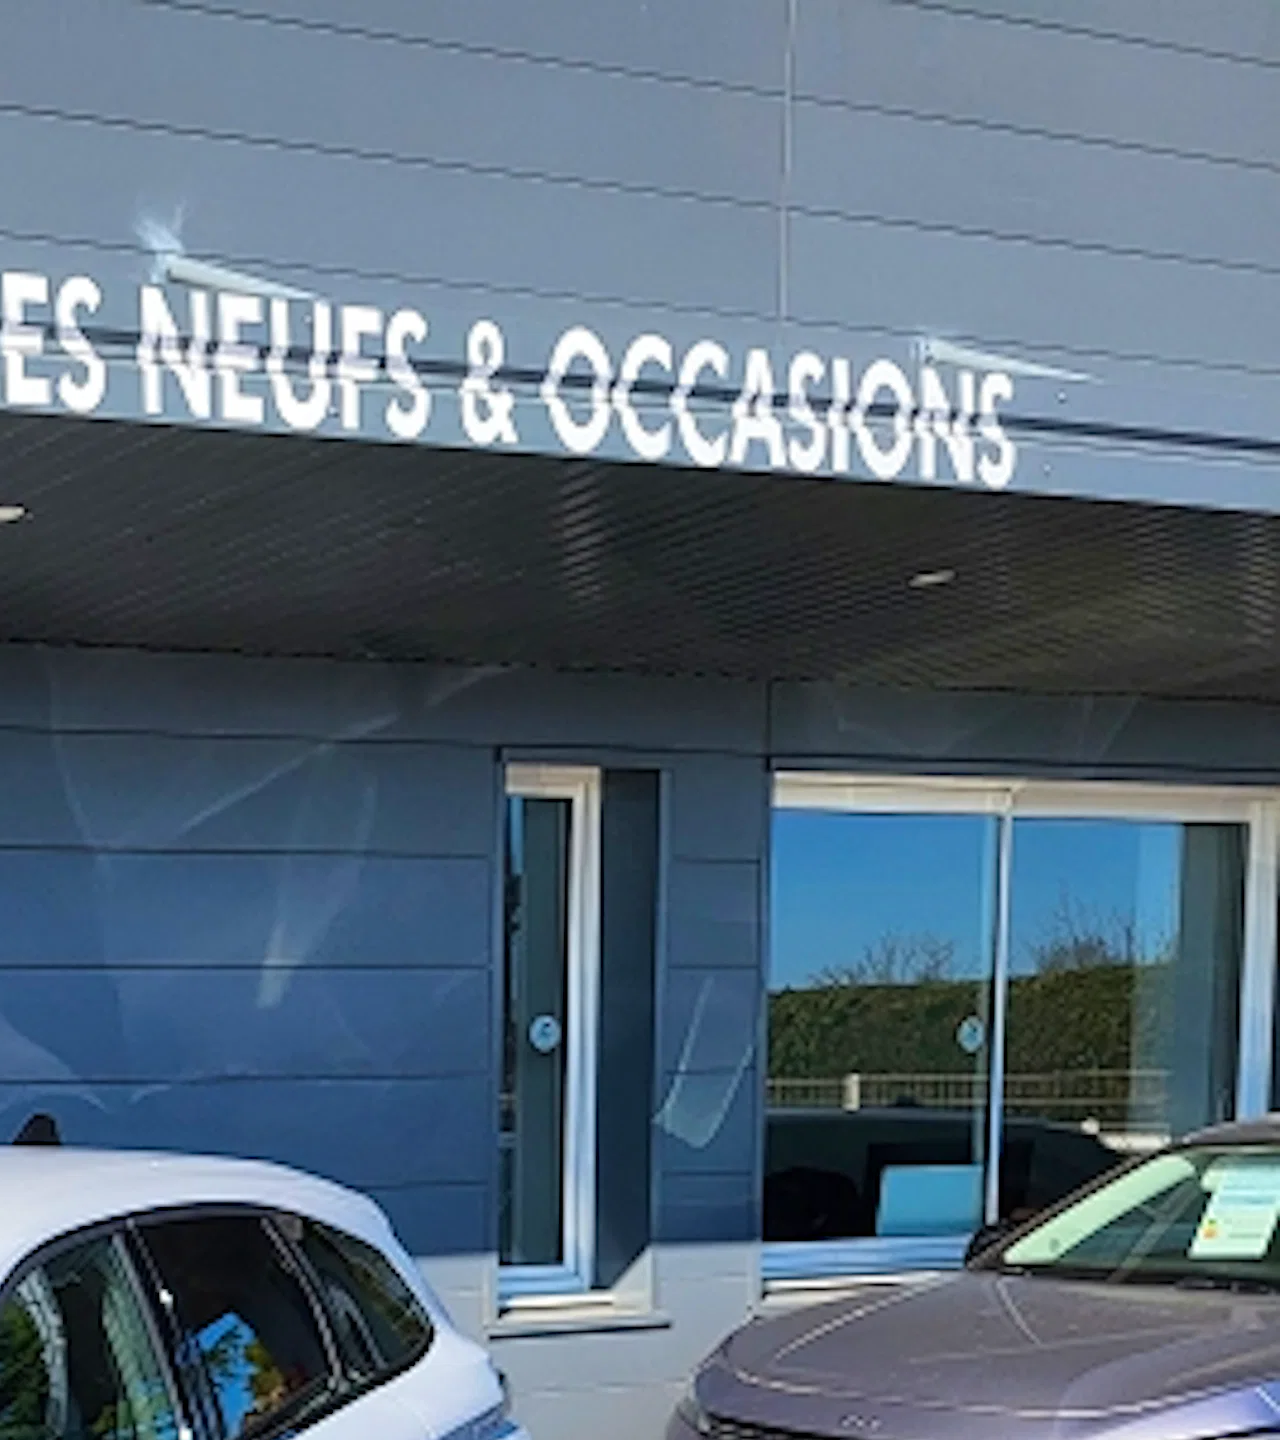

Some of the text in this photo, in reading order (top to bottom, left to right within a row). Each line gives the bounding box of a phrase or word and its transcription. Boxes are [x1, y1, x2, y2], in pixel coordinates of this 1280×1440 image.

[136, 285, 432, 438] NEUFS
[460, 318, 518, 446] &
[541, 327, 1017, 489] OCCASIONS
